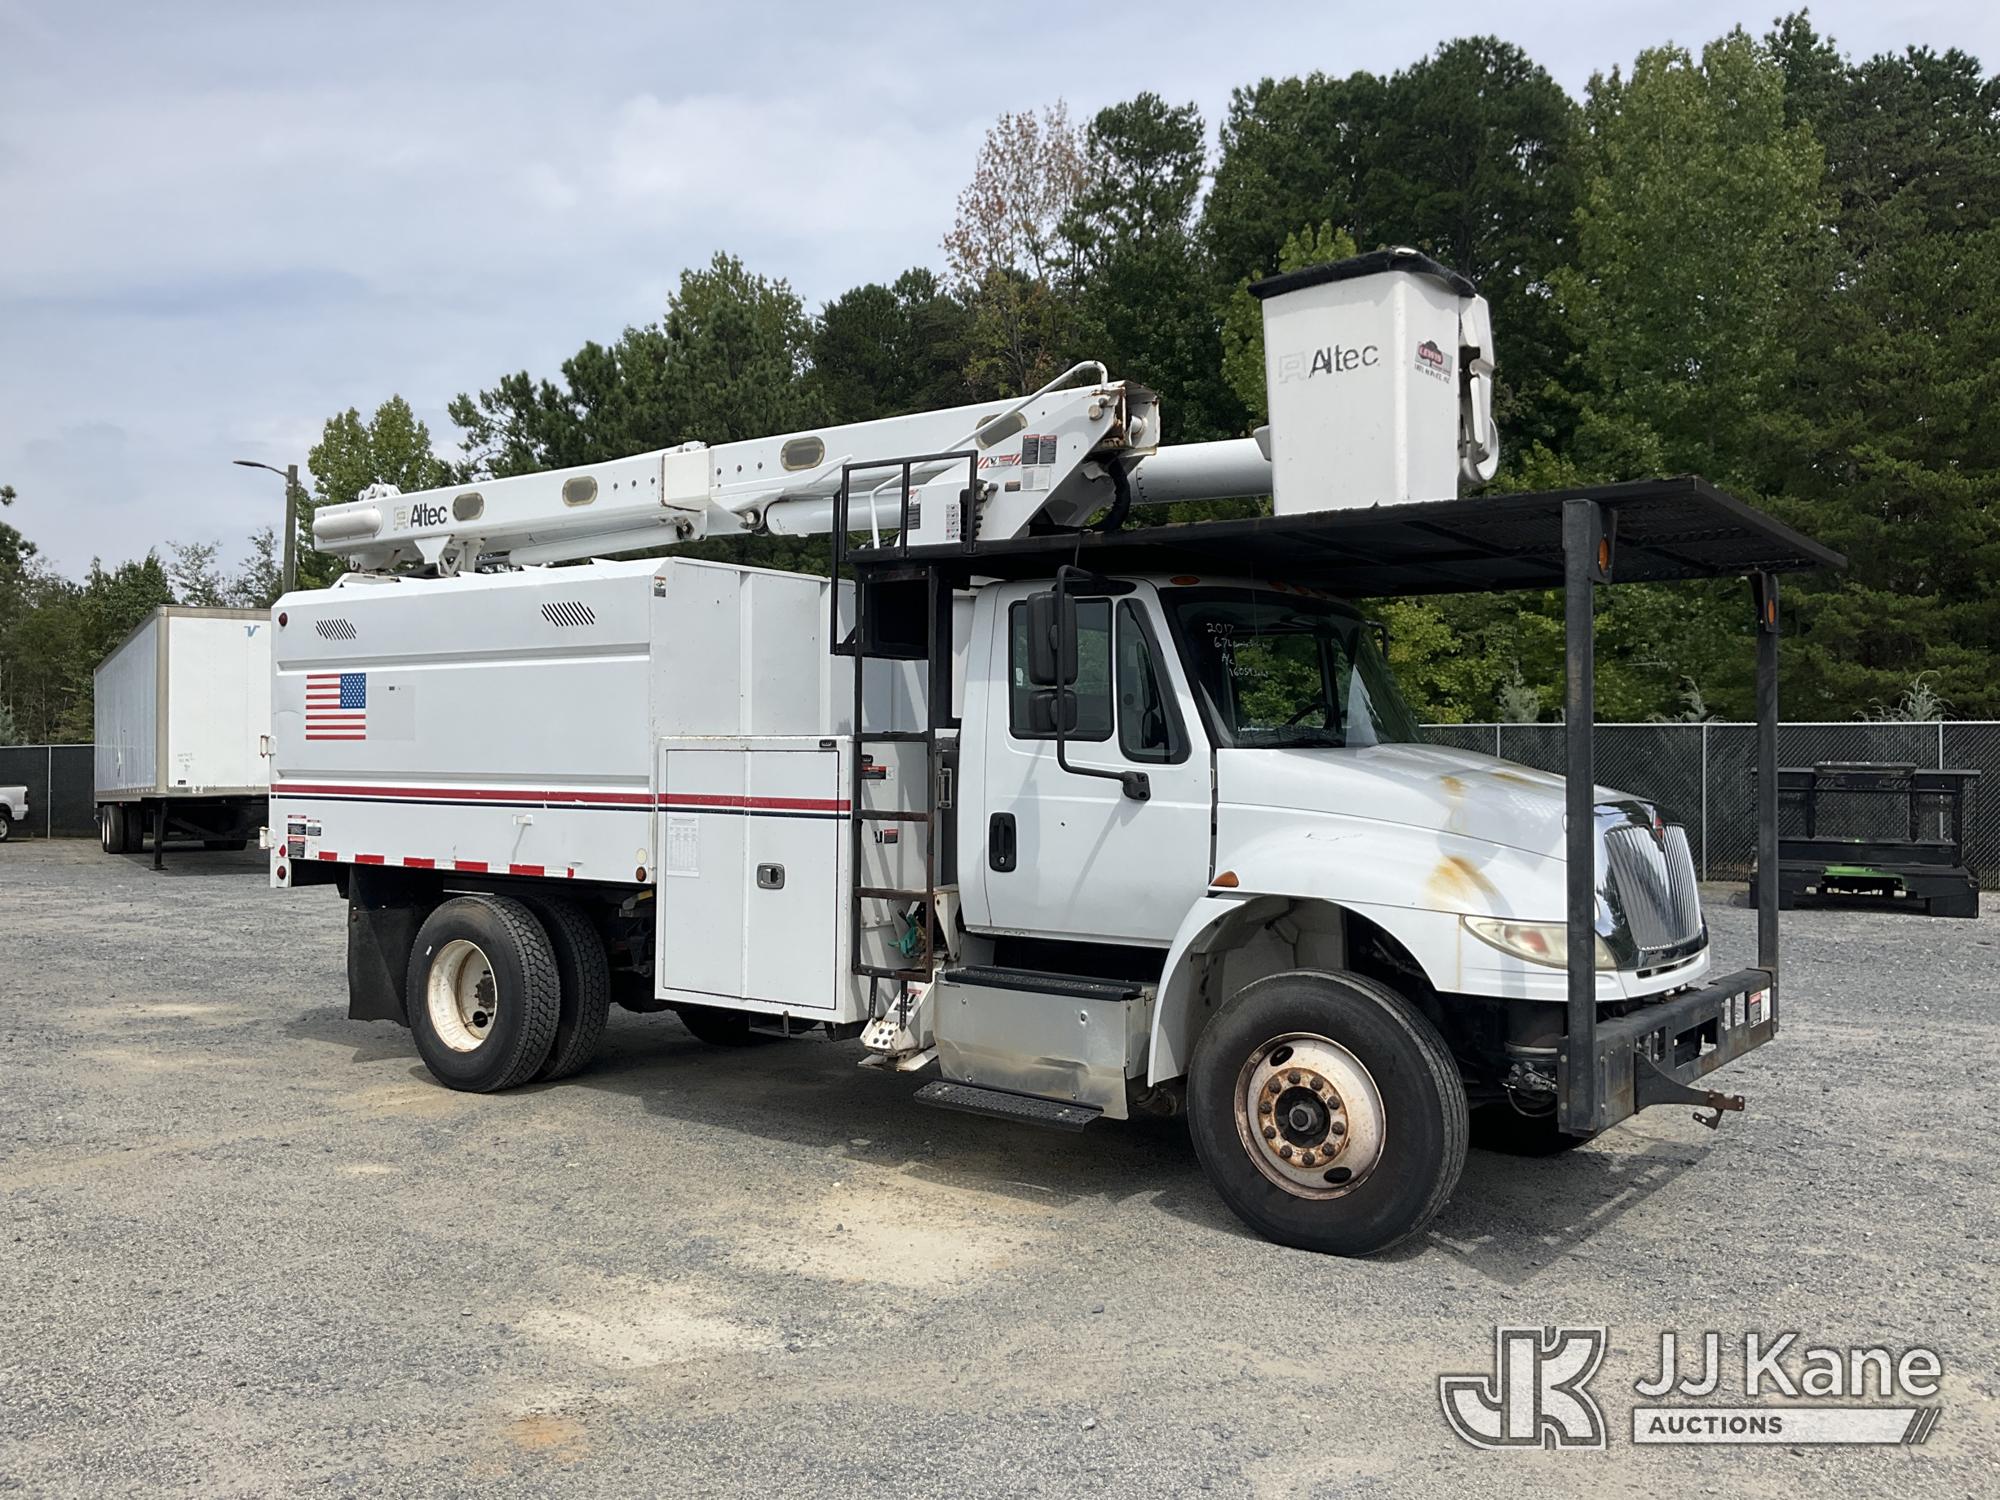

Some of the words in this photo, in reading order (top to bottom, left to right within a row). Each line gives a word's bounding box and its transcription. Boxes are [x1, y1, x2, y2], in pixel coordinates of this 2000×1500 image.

[1308, 344, 1379, 379] Altec
[410, 503, 448, 528] Altec
[1206, 622, 1234, 634] 2017
